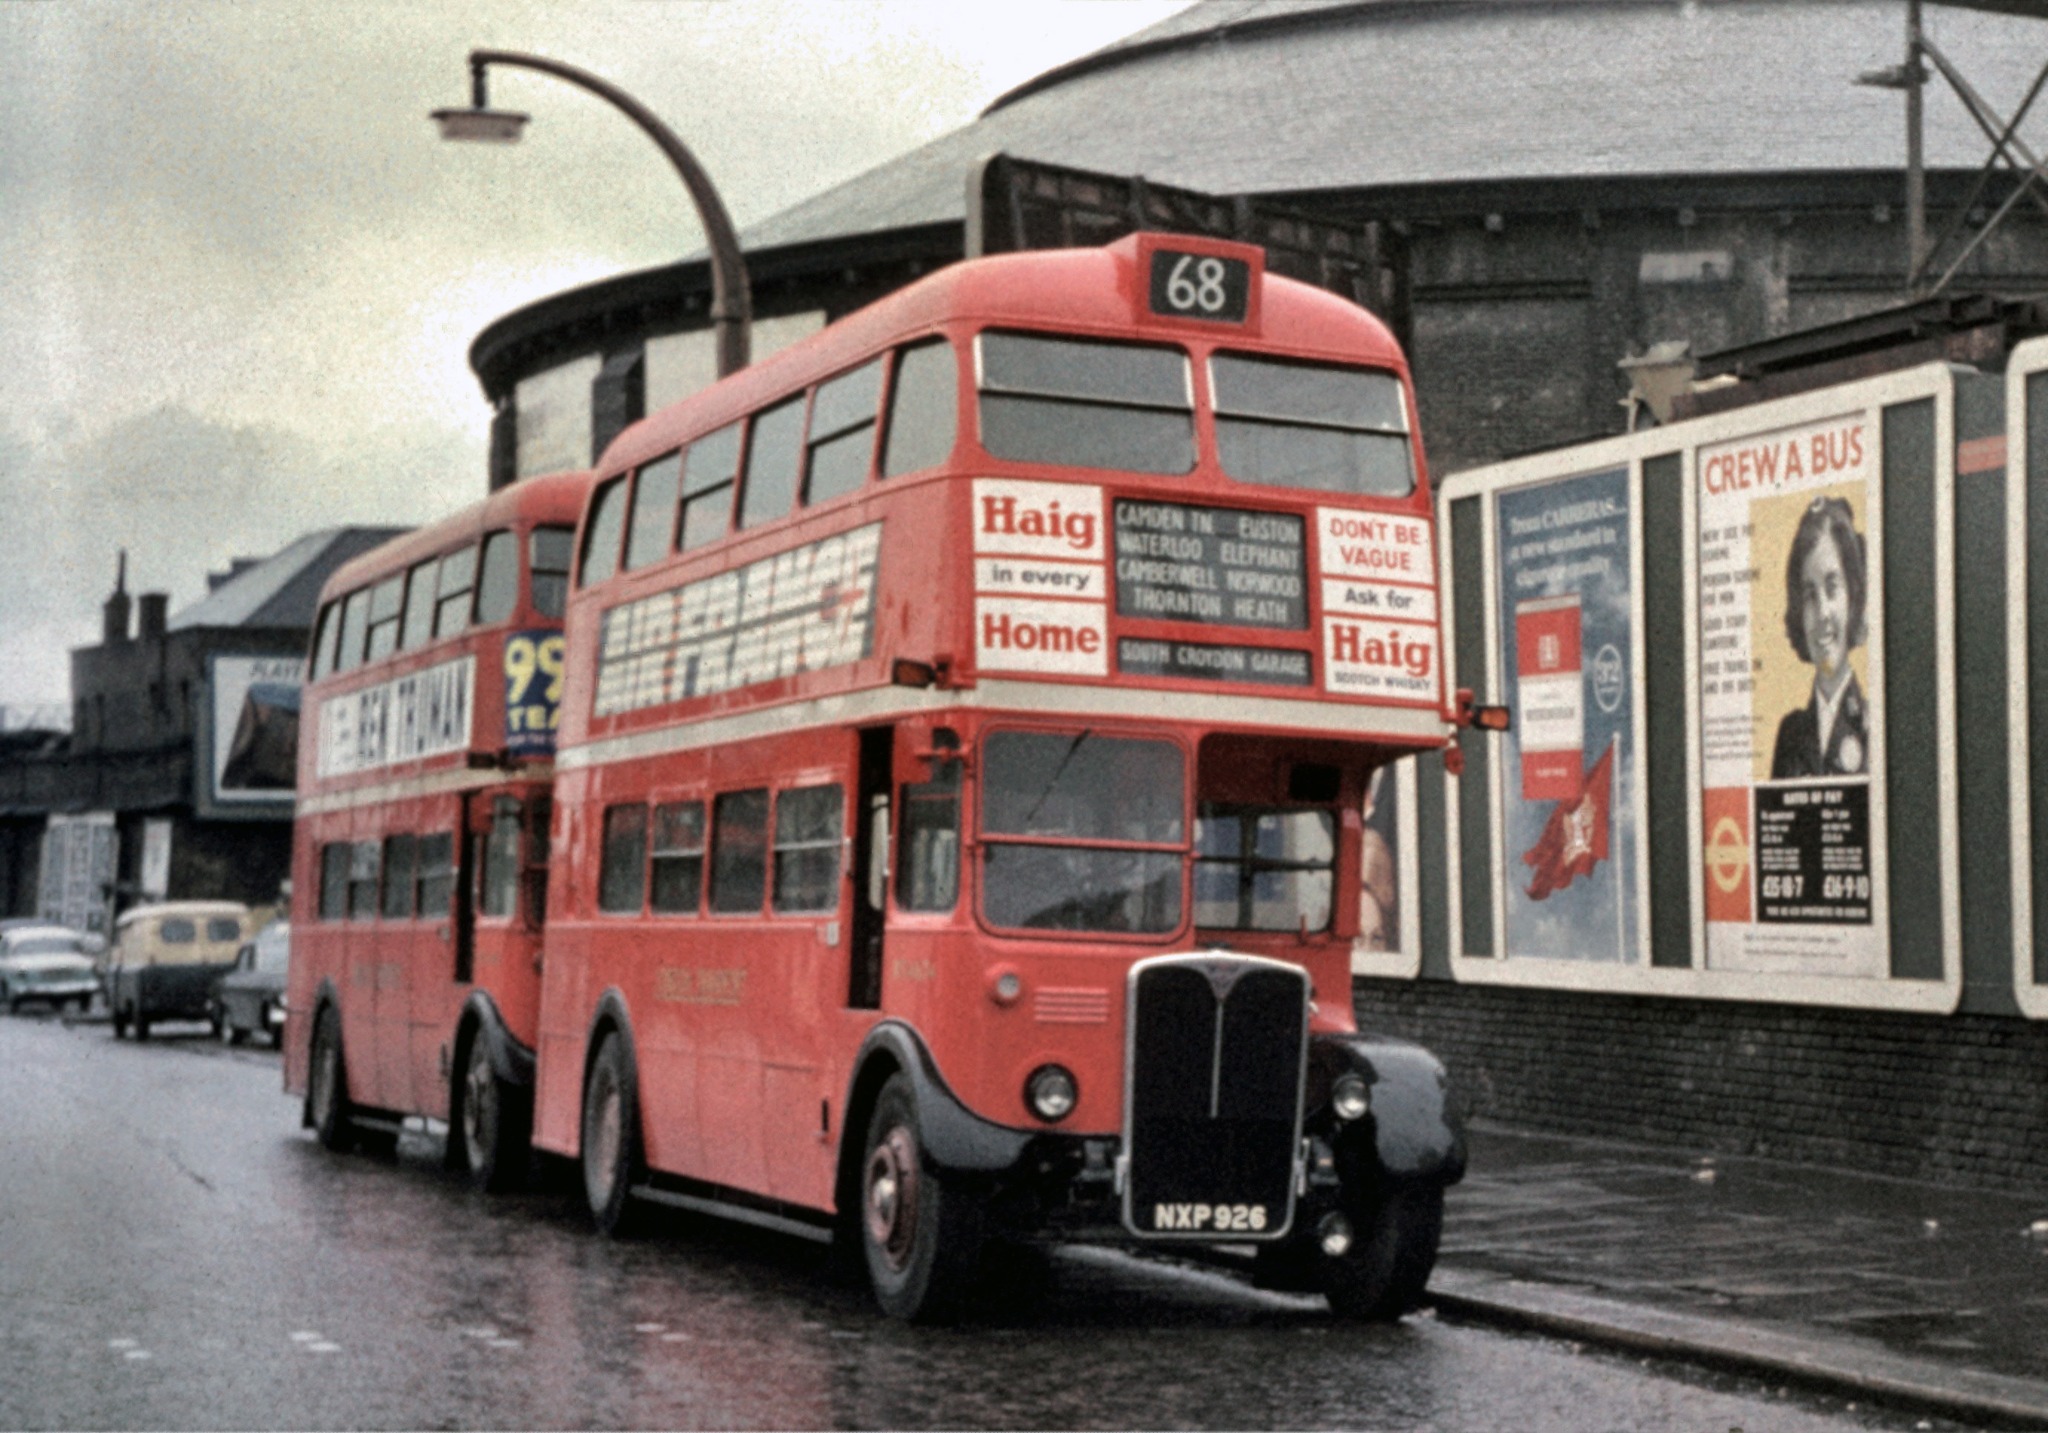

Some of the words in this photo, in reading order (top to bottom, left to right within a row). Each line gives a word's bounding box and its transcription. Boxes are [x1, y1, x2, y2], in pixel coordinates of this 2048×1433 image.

[1167, 254, 1225, 312] 68
[1705, 443, 1779, 495] CREW
[1784, 440, 1803, 480] A
[1811, 425, 1863, 475] BUS
[980, 495, 1096, 549] Haig
[1116, 503, 1184, 531] CAMDEN
[1239, 515, 1300, 543] EUSTON
[1330, 517, 1388, 541] DON'T
[1395, 525, 1420, 545] BE
[1117, 532, 1203, 560] WATERLOO
[1220, 541, 1299, 569] ELEPHANT
[1340, 546, 1411, 571] VAGUE
[991, 564, 1012, 583] in
[1021, 569, 1090, 590] every
[1117, 559, 1217, 590] CAMBERWELL
[1226, 570, 1300, 597] NORWOOD
[1134, 587, 1222, 616] THORNTON
[1235, 600, 1288, 623] HEATH
[1345, 588, 1379, 606] Ask
[1386, 589, 1413, 609] for
[982, 613, 1099, 653] Home
[1331, 624, 1431, 677] Haig
[505, 636, 566, 704] 99
[1121, 640, 1171, 663] SOUTH
[1177, 646, 1245, 670] CROYDON
[1251, 651, 1307, 675] GARAGE
[1334, 671, 1380, 686] SCOTCH
[1385, 676, 1431, 691] WHISKY
[1155, 1203, 1212, 1230] NXP
[1214, 1204, 1267, 1231] 926
